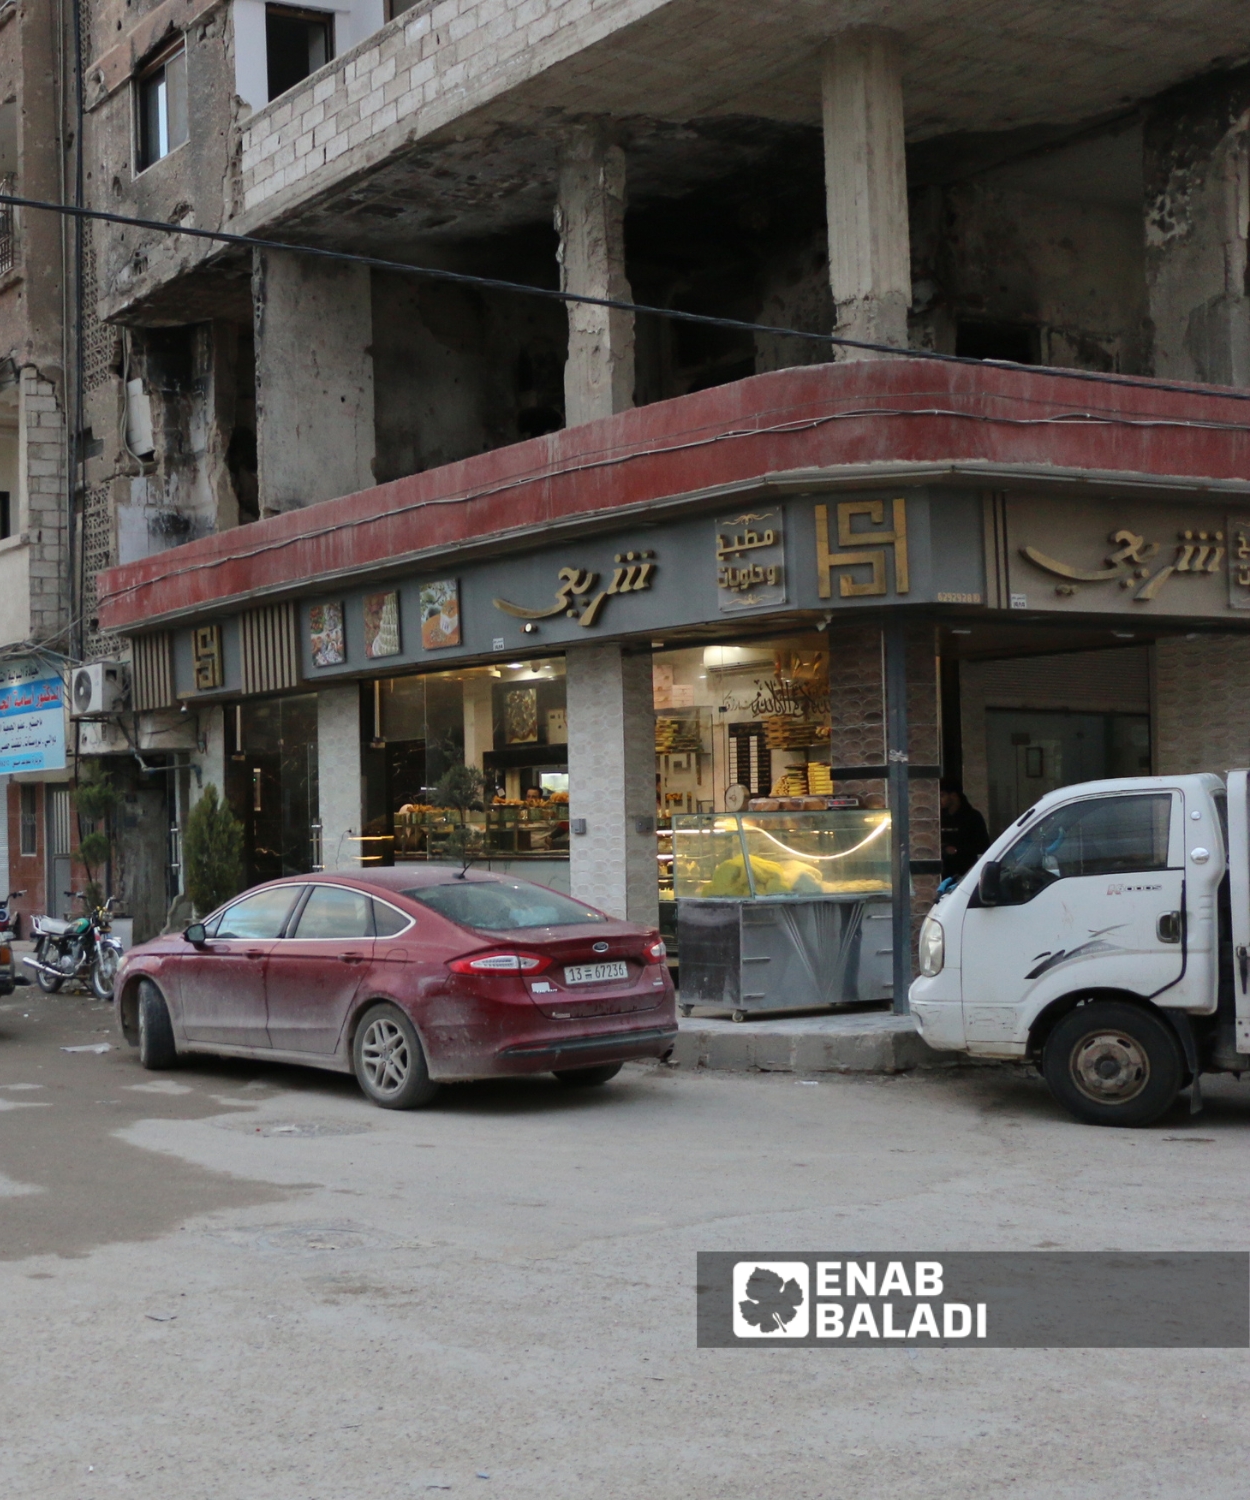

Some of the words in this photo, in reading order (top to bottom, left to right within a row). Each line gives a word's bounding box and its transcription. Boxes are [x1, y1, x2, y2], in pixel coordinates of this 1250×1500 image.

[715, 529, 774, 560] مطبخ
[570, 968, 583, 982] 13
[594, 963, 625, 979] 67236
